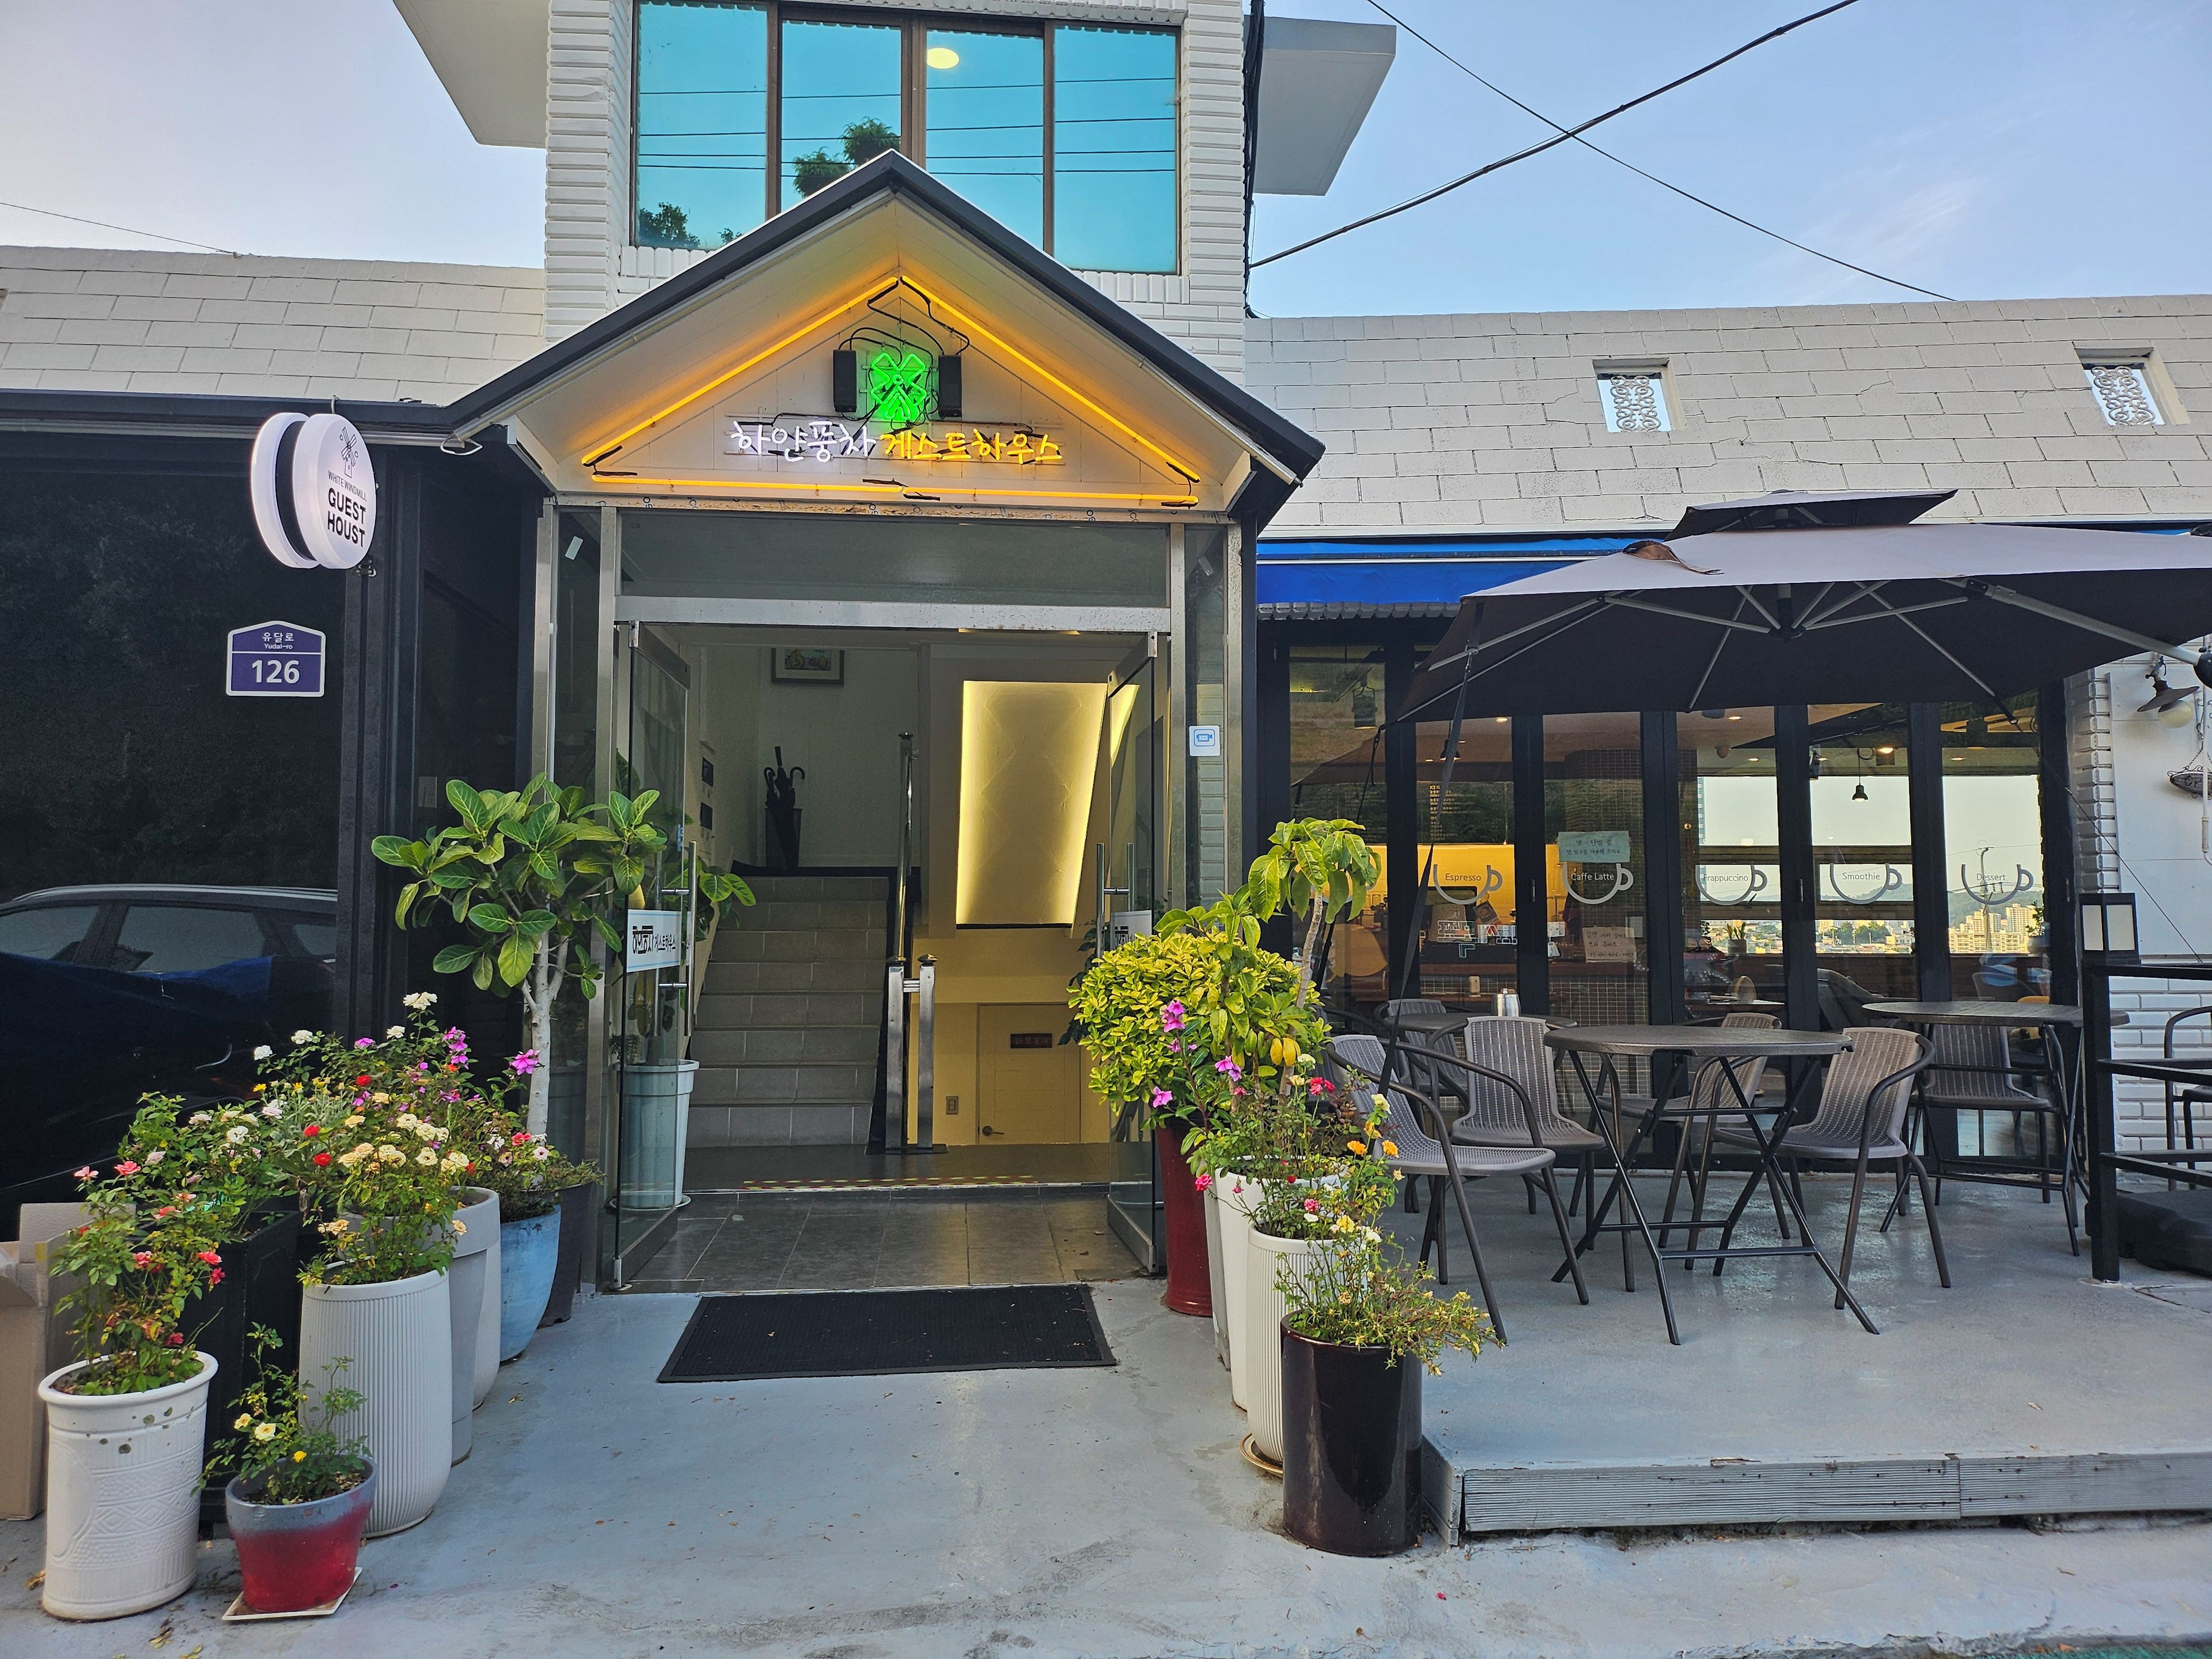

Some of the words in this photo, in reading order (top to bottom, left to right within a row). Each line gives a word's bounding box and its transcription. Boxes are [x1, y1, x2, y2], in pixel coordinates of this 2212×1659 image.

[730, 421, 877, 463] 하얀풍차
[879, 428, 1063, 464] 게스트하우스
[328, 470, 344, 487] WHITE
[344, 480, 368, 501] WINDMILL
[328, 487, 366, 525] GUEST
[262, 631, 295, 643] 유달로
[252, 660, 300, 684] 126
[1445, 873, 1482, 882] Espresso
[1570, 872, 1593, 881] Caffe
[1594, 872, 1615, 881] Latte
[1703, 873, 1749, 883] Frappuccino
[1842, 872, 1881, 881] Smoothie
